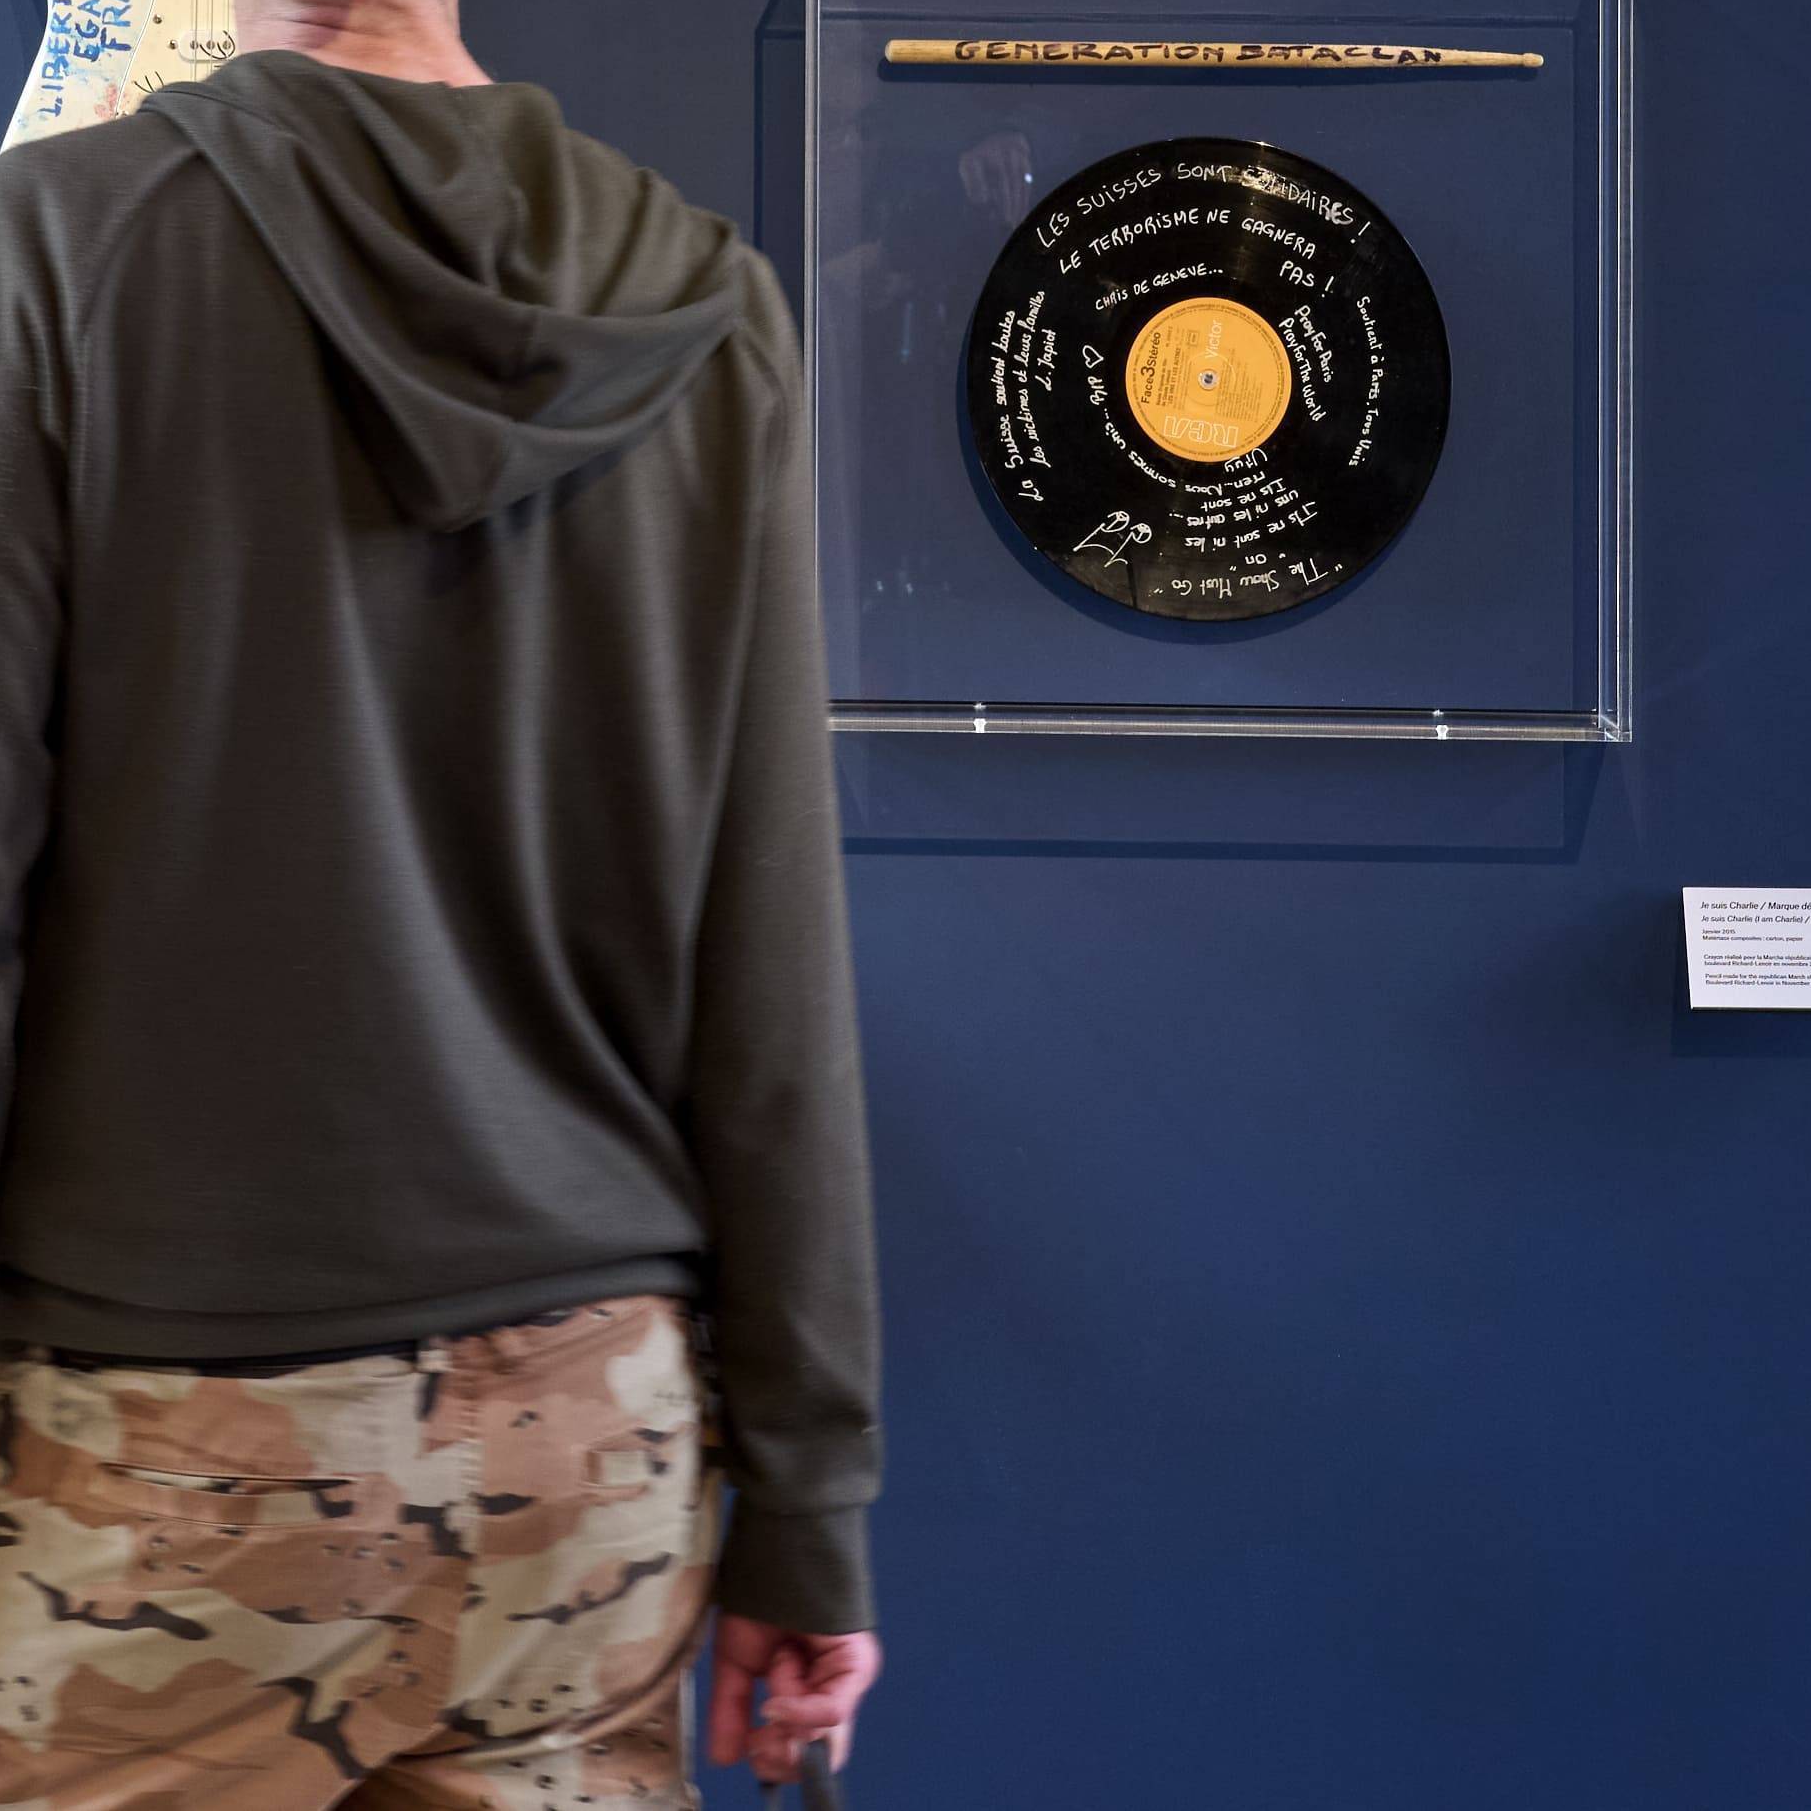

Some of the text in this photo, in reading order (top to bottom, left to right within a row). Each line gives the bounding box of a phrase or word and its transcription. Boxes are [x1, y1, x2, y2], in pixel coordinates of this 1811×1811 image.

[955, 39, 1442, 66] GENERATION BATACLAN
[1037, 213, 1070, 248] LES
[1177, 162, 1232, 183] SONT
[1059, 250, 1082, 274] LE
[1206, 209, 1231, 224] NE
[1241, 217, 1316, 260] GAGNERA
[1279, 260, 1315, 287] PAS
[1133, 283, 1150, 296] DE
[1017, 291, 1046, 334] familles
[1205, 319, 1223, 360] Victor
[1294, 304, 1317, 338] Pray
[1318, 349, 1334, 383] Paris
[1012, 370, 1028, 383] et
[1278, 317, 1299, 353] Pray
[1301, 383, 1327, 422] World
[990, 310, 1044, 501] La Suisse soutient toutes
[1016, 388, 1040, 442] victimes
[1163, 415, 1238, 448] RCA
[1361, 407, 1379, 435] Tous
[1201, 498, 1233, 512] sont
[1233, 529, 1261, 549] sont
[1267, 520, 1286, 534] ne
[1185, 537, 1205, 552] les
[1200, 578, 1232, 599] Must
[1239, 570, 1280, 592] Show
[1701, 902, 1709, 910] Je
[1711, 902, 1728, 910] suis
[1729, 902, 1759, 910] Charlie
[1768, 902, 1800, 911] Marque
[1775, 916, 1803, 924] Charlie)
